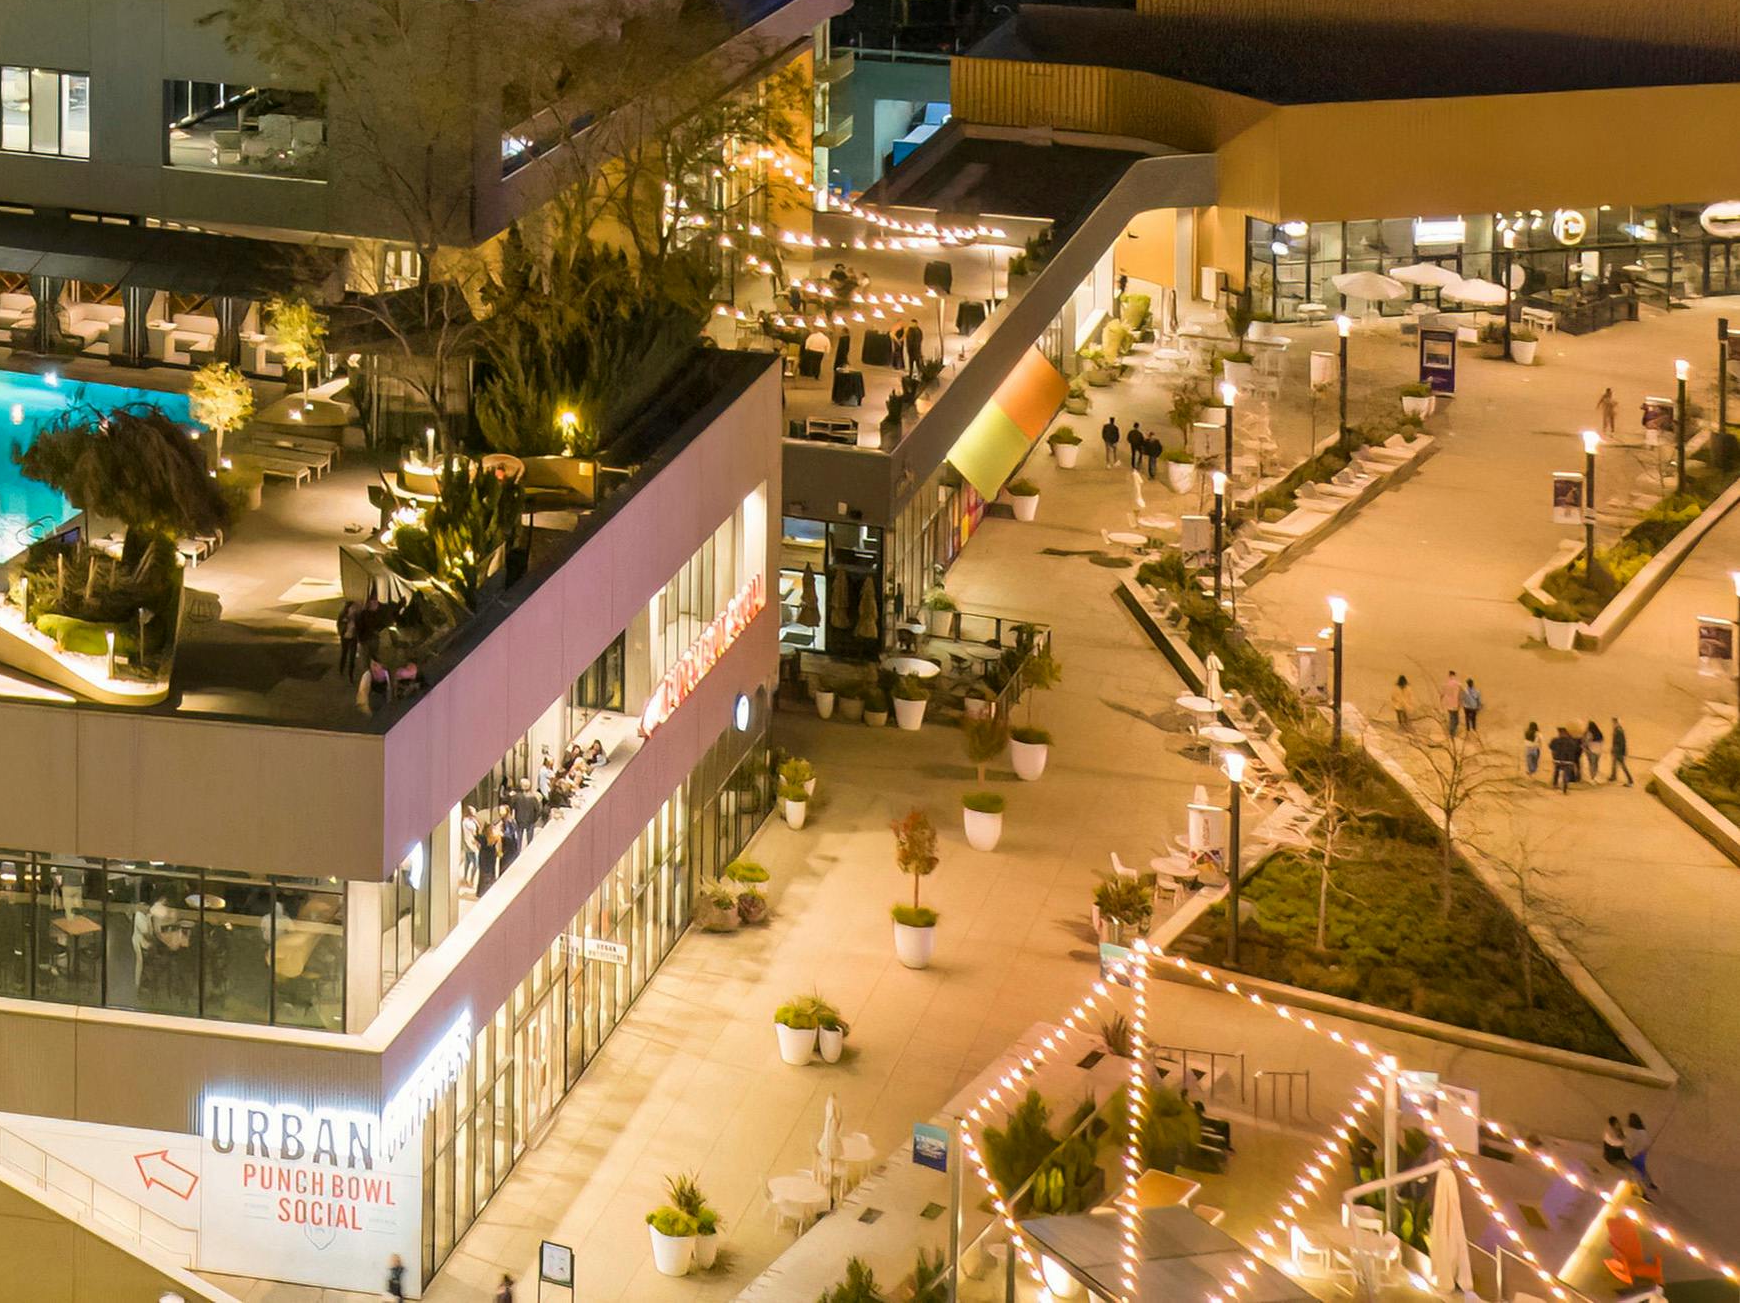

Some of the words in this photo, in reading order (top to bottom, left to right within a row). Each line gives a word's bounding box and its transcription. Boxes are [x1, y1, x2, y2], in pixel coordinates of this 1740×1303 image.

[212, 1106, 372, 1170] URBAN
[244, 1163, 324, 1195] PUNCH
[332, 1174, 396, 1205] BOWL
[278, 1198, 362, 1230] SOCIAL
